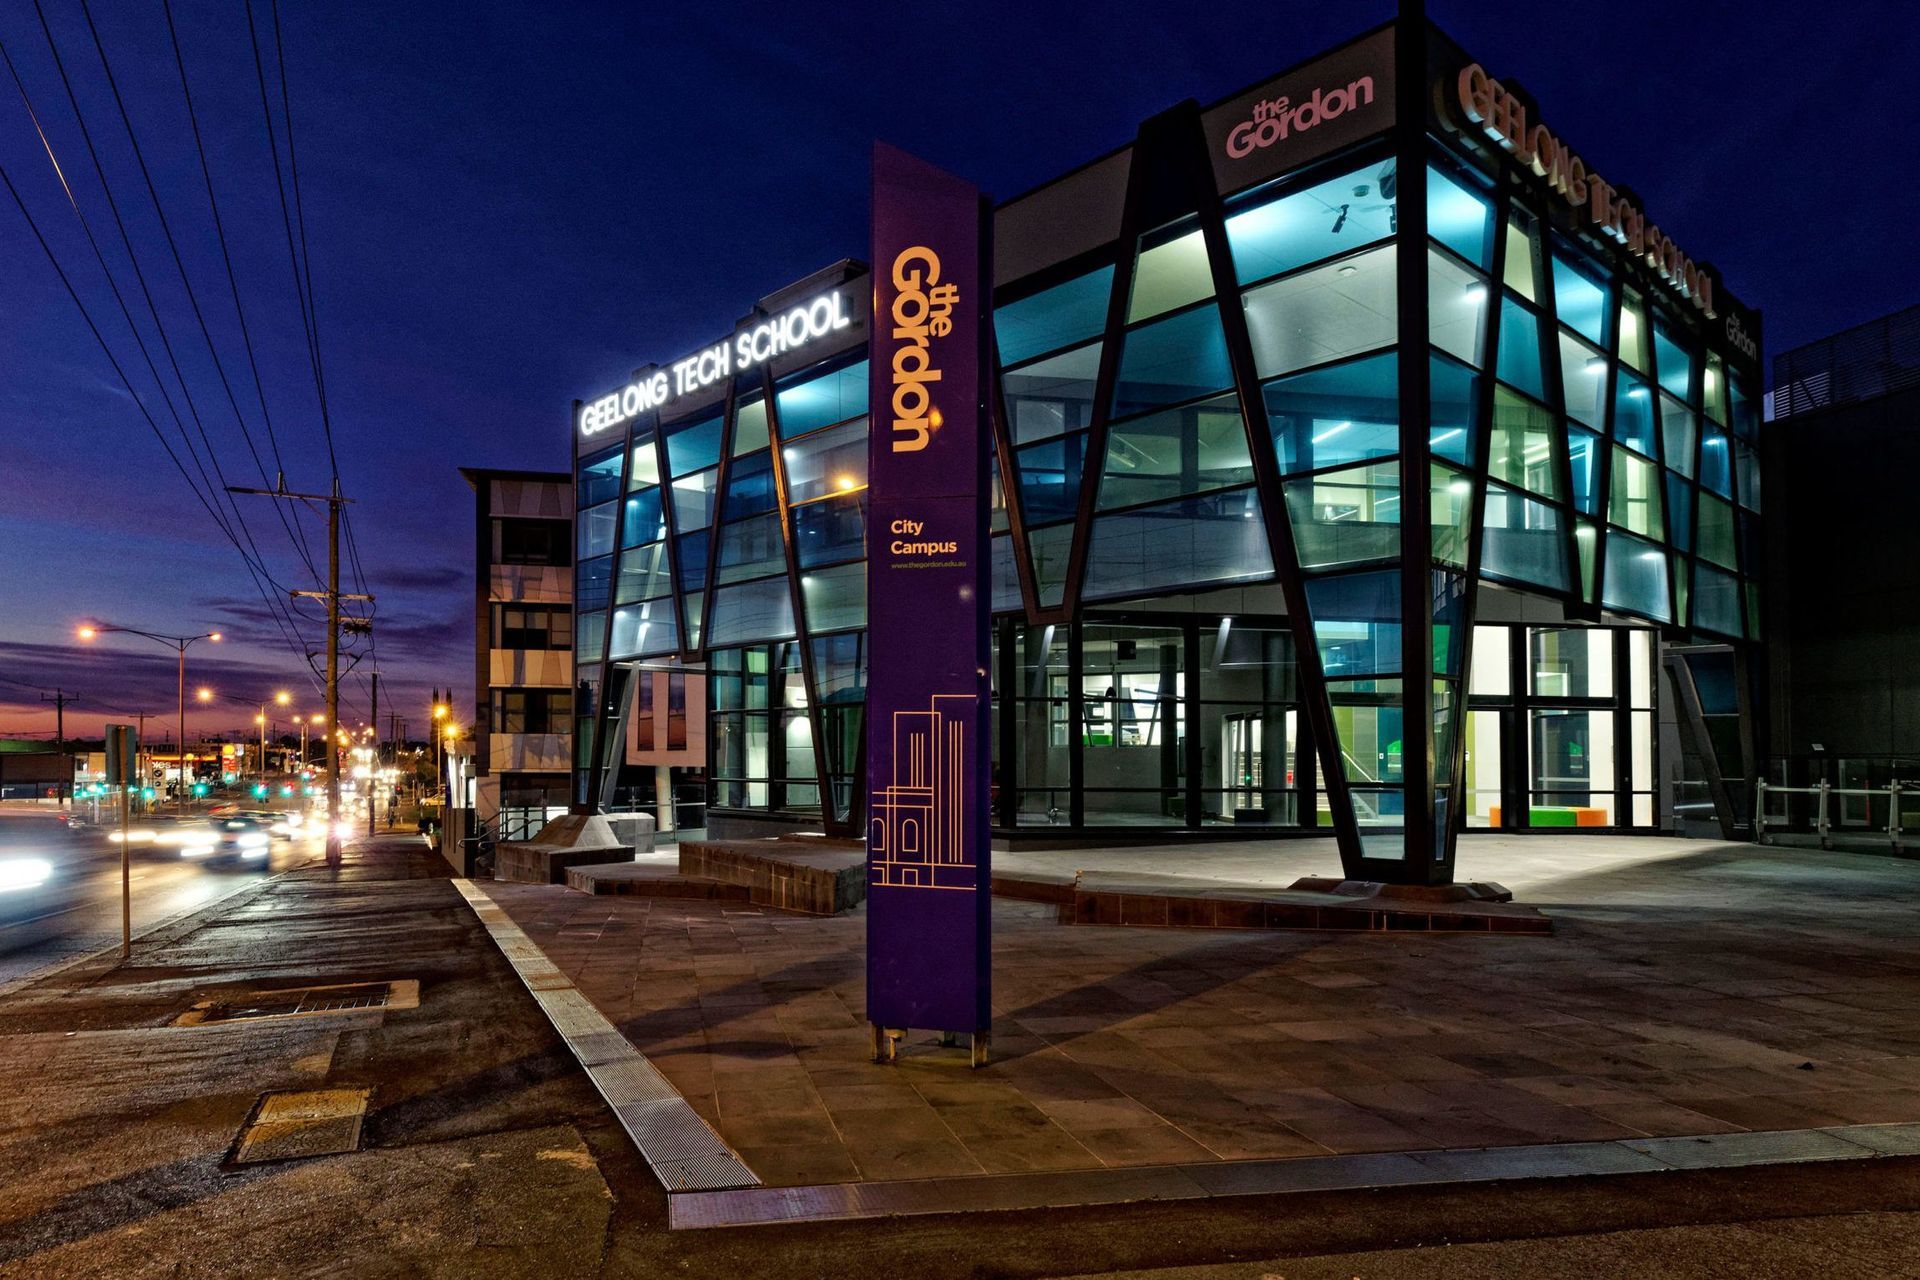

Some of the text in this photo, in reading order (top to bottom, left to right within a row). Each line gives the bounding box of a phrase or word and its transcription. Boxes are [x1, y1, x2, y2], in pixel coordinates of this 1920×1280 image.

[1226, 76, 1373, 159] Gordon
[1252, 96, 1289, 124] the
[929, 283, 960, 338] the
[581, 291, 850, 436] GEELONG TECH SCHOOL
[892, 246, 942, 453] Gordon
[890, 519, 924, 536] City
[890, 540, 958, 557] Campus
